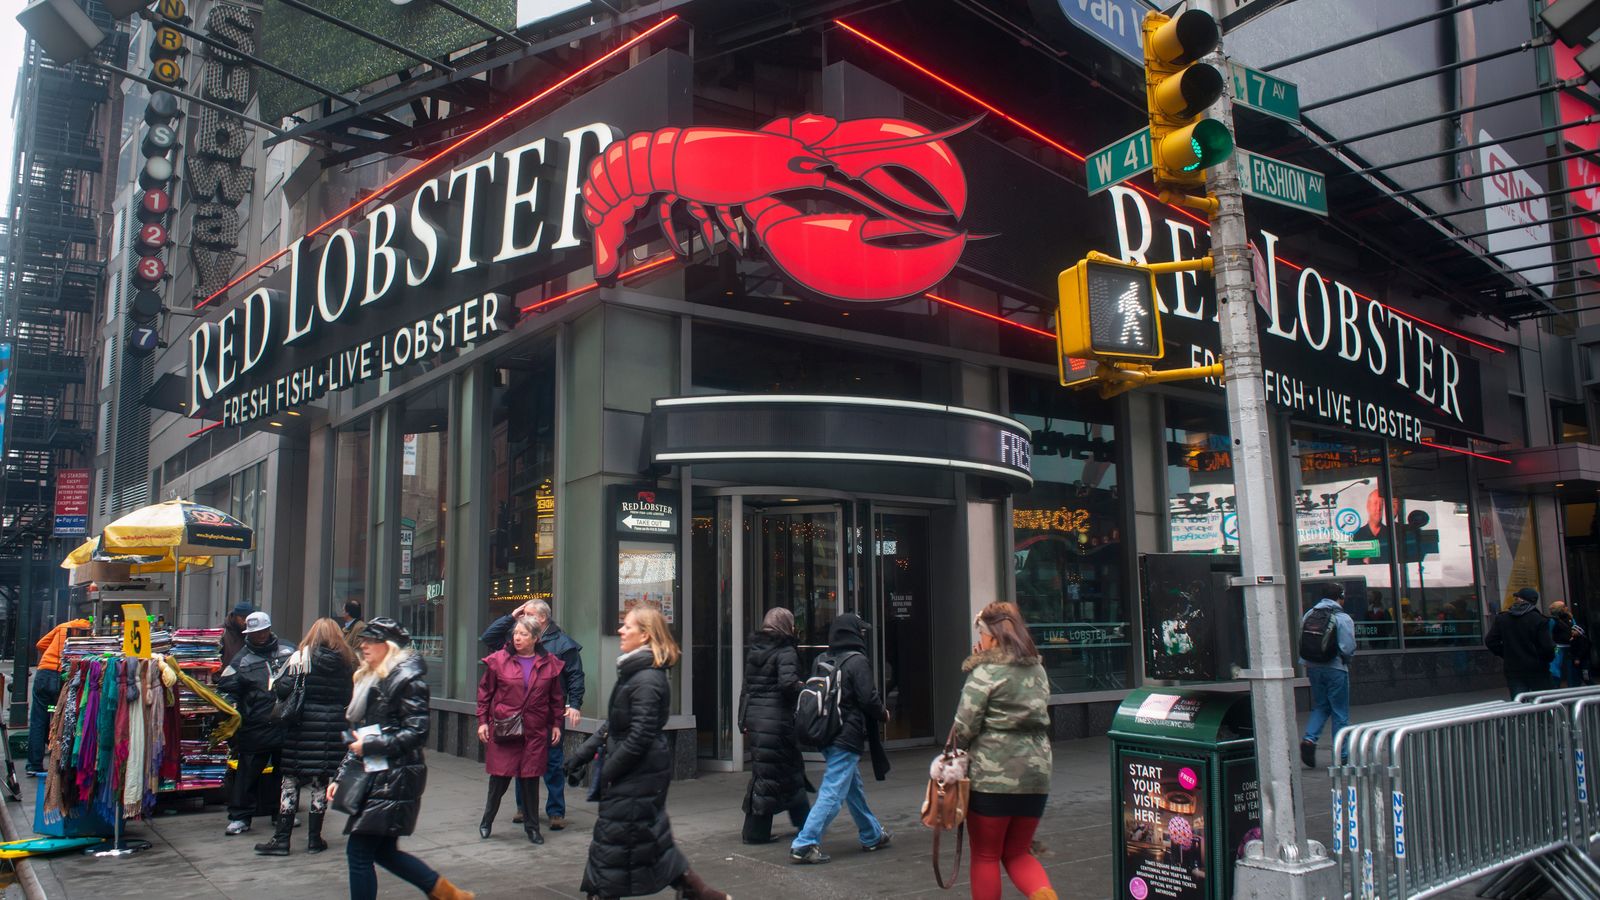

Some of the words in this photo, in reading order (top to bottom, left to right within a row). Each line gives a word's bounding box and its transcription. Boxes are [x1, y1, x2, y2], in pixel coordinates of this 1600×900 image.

[160, 0, 180, 17] N
[160, 32, 179, 48] R
[158, 62, 177, 82] Q
[1252, 75, 1267, 107] 7
[1272, 82, 1286, 101] AV
[154, 128, 171, 145] S
[1095, 157, 1113, 186] W
[1123, 134, 1149, 170] 41
[1254, 160, 1307, 204] FASHION
[1309, 172, 1323, 194] AV
[1489, 152, 1543, 229] GNC
[149, 192, 160, 210] 1
[146, 227, 162, 245] 2
[143, 260, 160, 278] 3
[1108, 185, 1220, 323] RE
[1261, 229, 1463, 424] LOBSTER
[139, 329, 153, 346] 7
[188, 287, 272, 418] RED
[223, 383, 269, 428] FRESH
[276, 365, 313, 411] FISH
[329, 341, 372, 391] LIVE
[381, 292, 498, 371] LOBSTER
[1265, 369, 1305, 411] FISH
[1318, 386, 1352, 425] LIVE
[1358, 400, 1423, 445] LOBSTER
[622, 501, 639, 511] RED
[640, 501, 673, 514] LOBSTER
[130, 620, 142, 654] $5
[1043, 630, 1065, 641] LIVE
[1069, 630, 1107, 640] LOBSTER
[1174, 704, 1200, 712] SQUARE
[1129, 763, 1163, 779] START
[1576, 751, 1586, 800] NYPD
[1132, 779, 1161, 794] YOUR
[1242, 781, 1257, 791] COME
[1133, 794, 1161, 809] VISIT
[1234, 793, 1244, 802] THE
[1233, 802, 1246, 812] NEW
[1134, 809, 1162, 825] HERE
[1348, 786, 1359, 849] NYPD
[1393, 793, 1405, 855] NYPD
[1140, 865, 1161, 874] CENTENNIAL
[1156, 862, 1170, 870] SQUARE
[1170, 865, 1187, 873] MUSEUM
[1149, 880, 1165, 888] OFFICIAL
[1181, 881, 1197, 889] TICKETS
